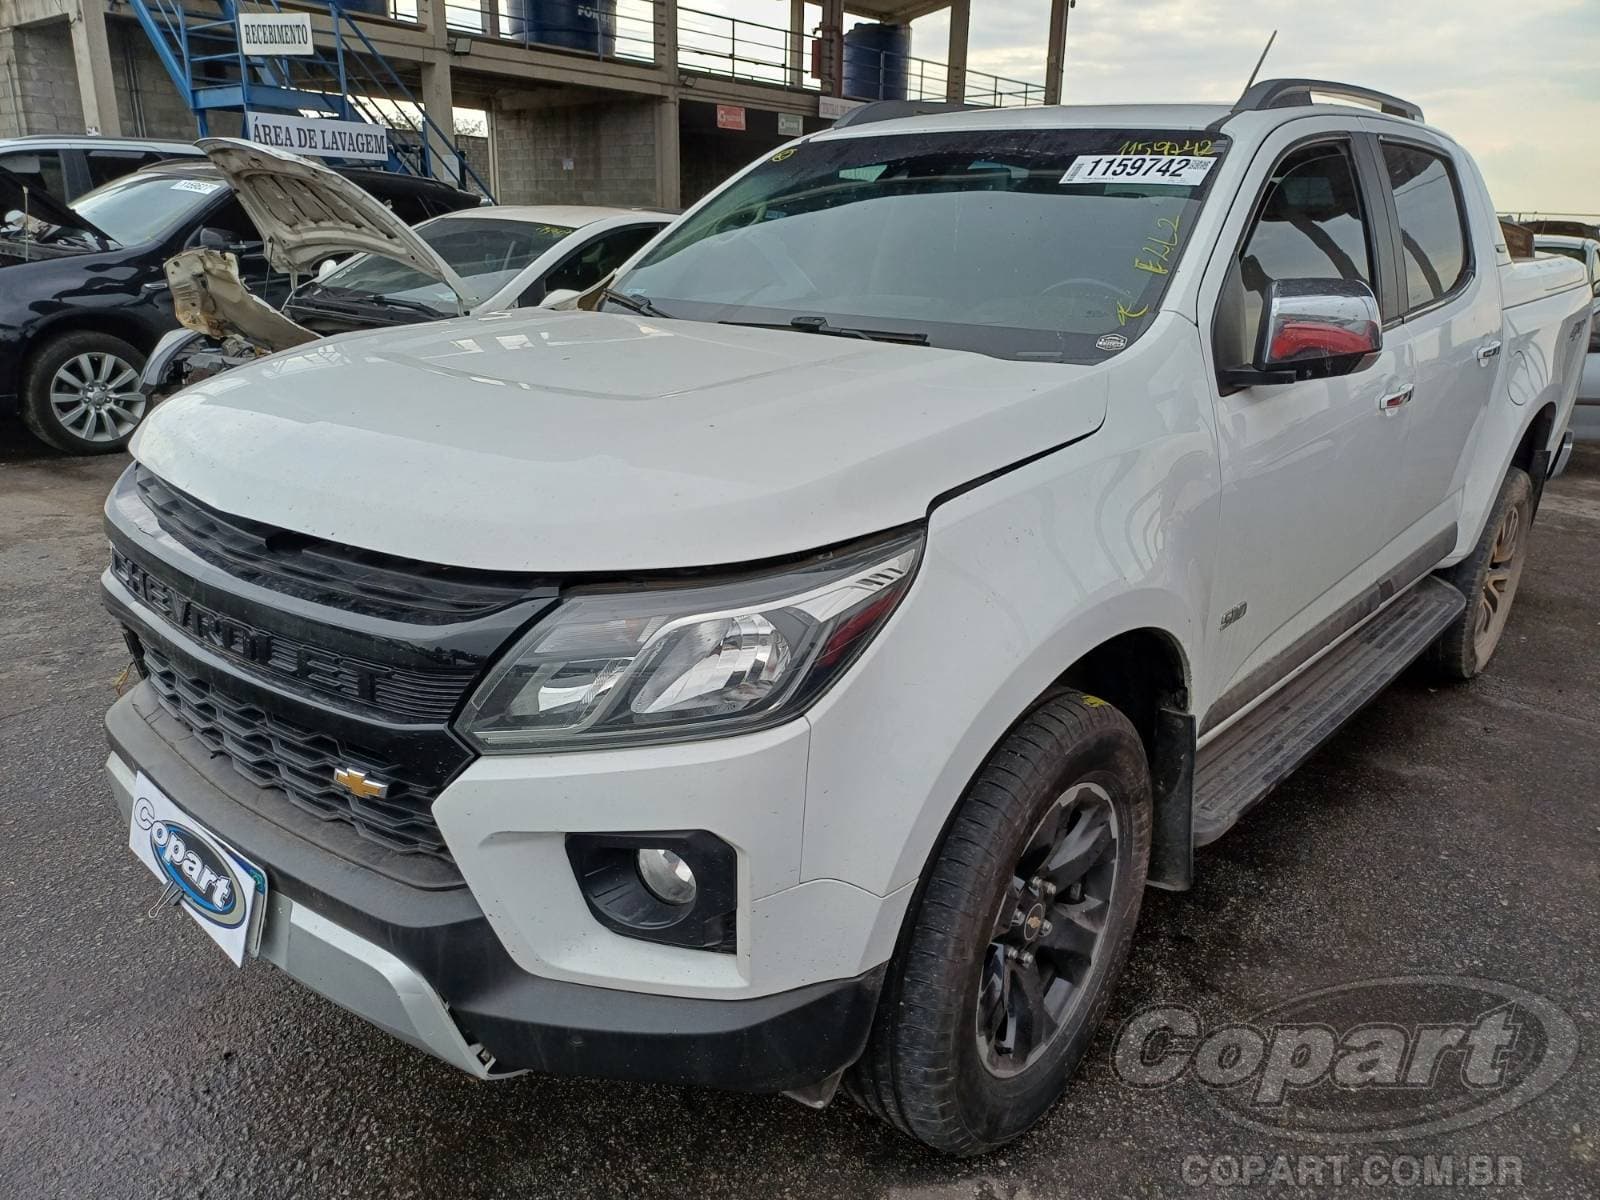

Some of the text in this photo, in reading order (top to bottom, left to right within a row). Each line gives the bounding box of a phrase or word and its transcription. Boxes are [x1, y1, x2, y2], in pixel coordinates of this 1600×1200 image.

[244, 23, 308, 46] RECEBIMENTO
[252, 116, 386, 155] ÁREA DE LAVAGEM
[1086, 157, 1191, 177] 1159742
[113, 550, 393, 702] CHEVROLET
[133, 796, 233, 912] Copart
